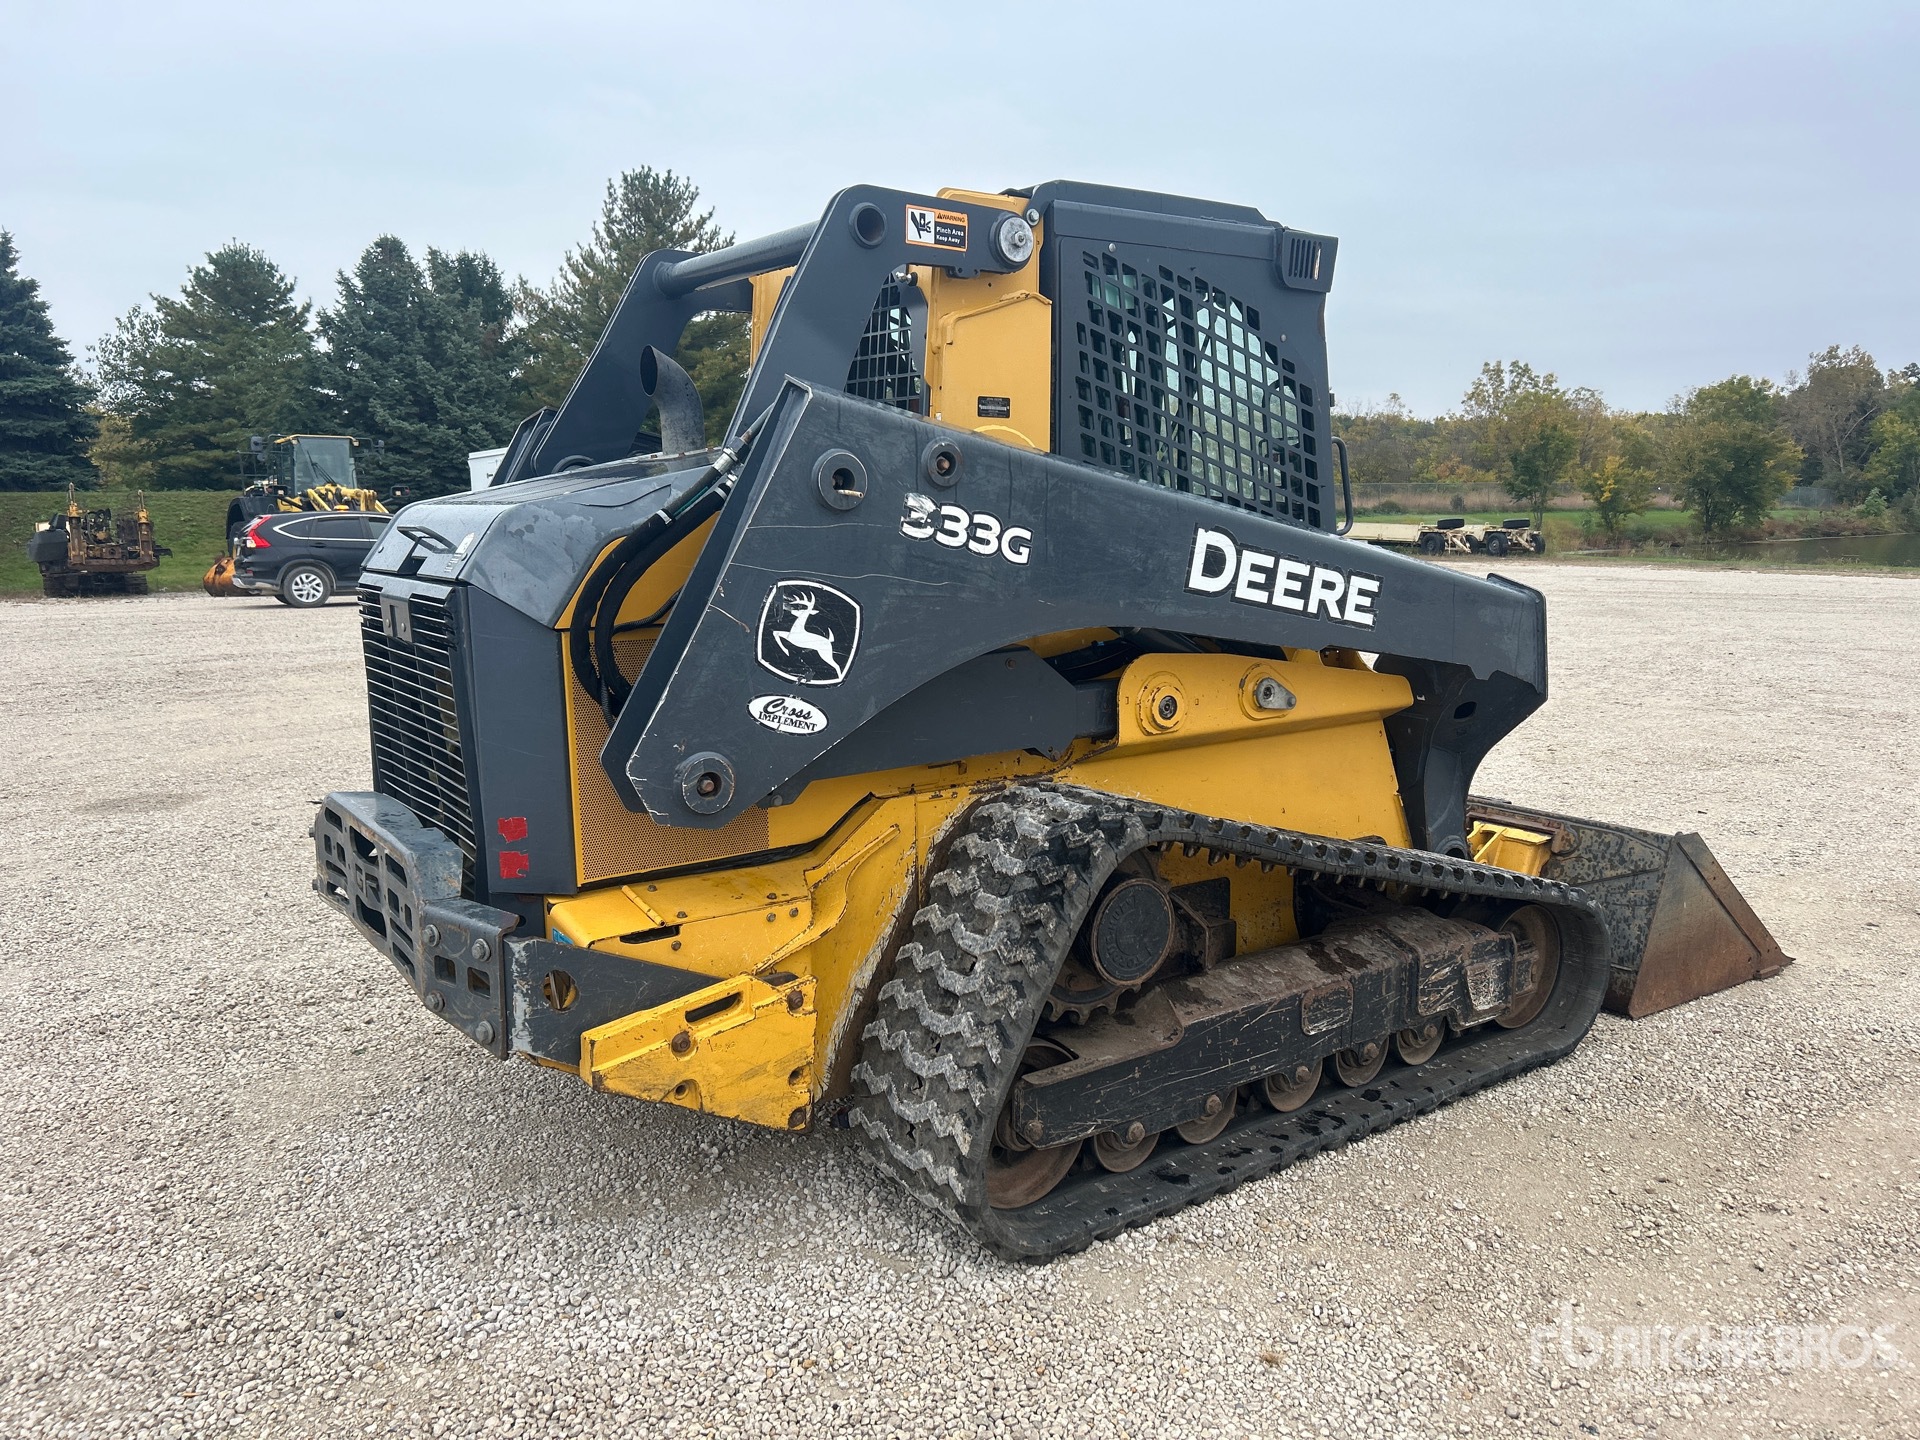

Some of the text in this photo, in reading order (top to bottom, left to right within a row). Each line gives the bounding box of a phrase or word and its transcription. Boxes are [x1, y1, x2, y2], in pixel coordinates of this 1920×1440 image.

[942, 214, 965, 223] WARNING
[936, 226, 964, 237] Pinch Area
[936, 234, 960, 244] Keep Away
[1189, 527, 1380, 626] DEERE
[763, 698, 812, 720] Cross
[758, 711, 817, 731] IMPLEMENT
